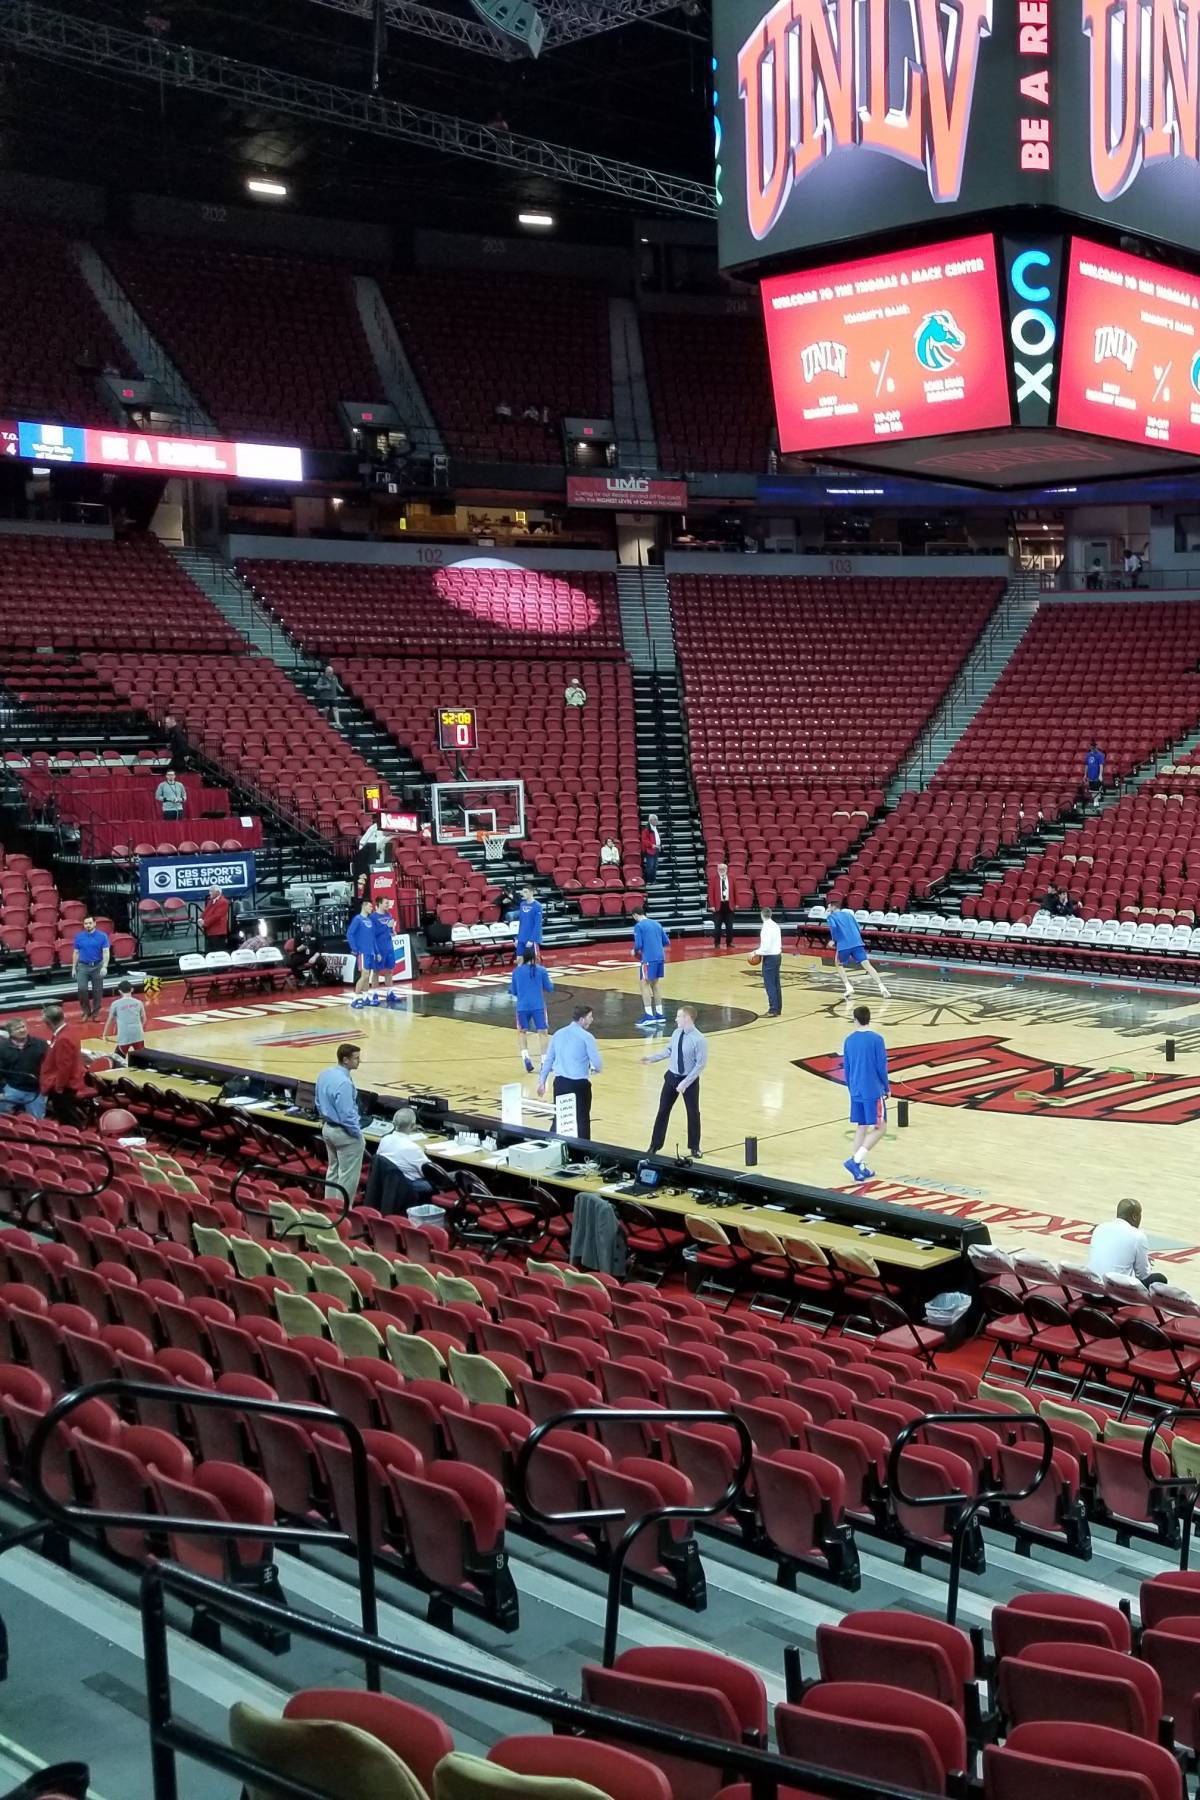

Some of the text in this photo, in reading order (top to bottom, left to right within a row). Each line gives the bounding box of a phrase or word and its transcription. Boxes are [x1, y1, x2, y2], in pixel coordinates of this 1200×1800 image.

[1020, 70, 1049, 105] A
[738, 0, 995, 241] UNLV
[1020, 118, 1050, 171] BE
[1011, 250, 1056, 404] COX
[1094, 326, 1138, 373] UNLV
[801, 341, 848, 383] UNLV
[6, 443, 17, 455] 4
[606, 478, 648, 491] UMC
[416, 548, 442, 563] 102
[830, 559, 852, 574] 103
[441, 712, 472, 725] 52:08
[456, 725, 469, 745] 0
[177, 866, 242, 879] CBS SPORTS
[177, 875, 233, 888] NETWORK
[432, 960, 643, 989] REELS
[263, 1566, 273, 1584] HH
